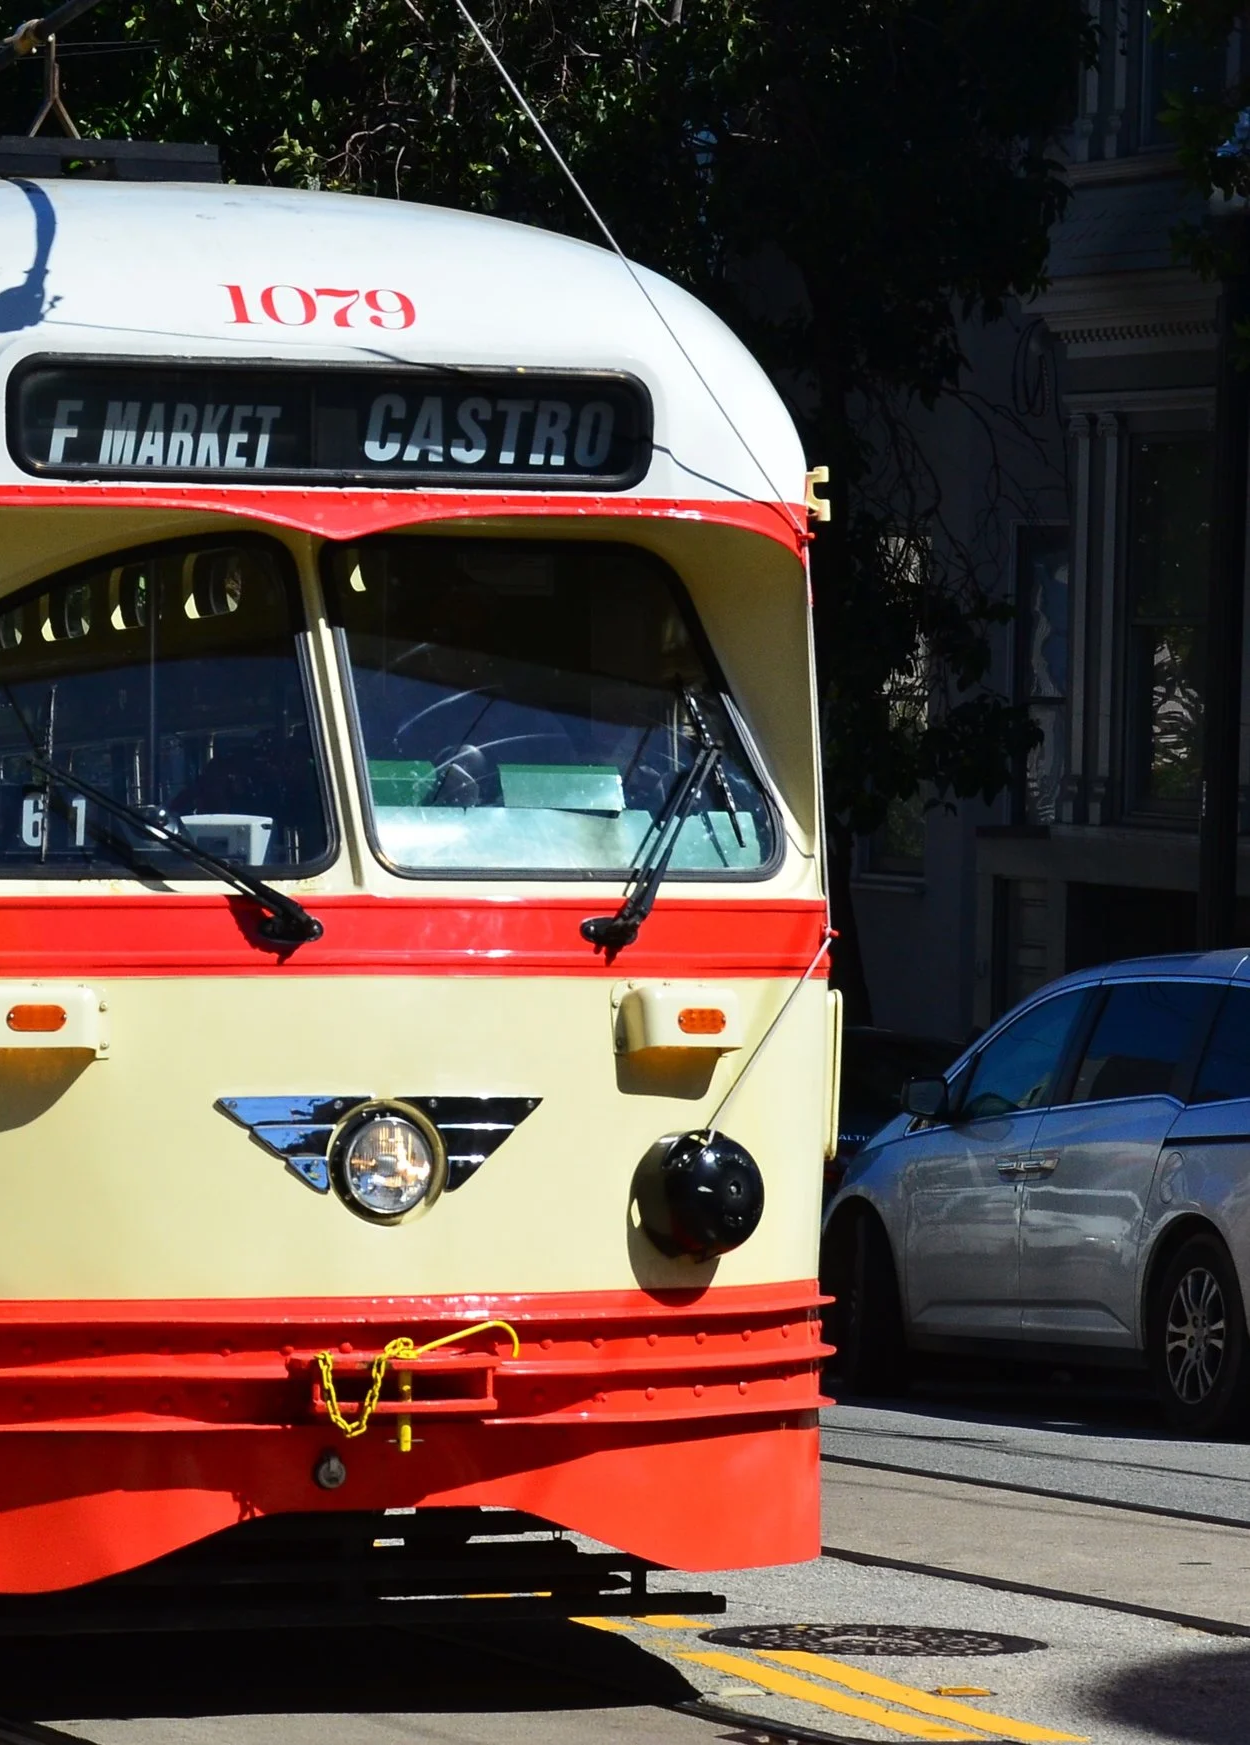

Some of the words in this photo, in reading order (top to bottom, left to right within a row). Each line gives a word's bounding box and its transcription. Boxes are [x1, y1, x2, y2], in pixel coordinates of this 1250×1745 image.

[219, 284, 417, 330] 1079
[50, 400, 84, 464] F
[99, 401, 282, 469] MARKET
[364, 394, 615, 468] CASTRO
